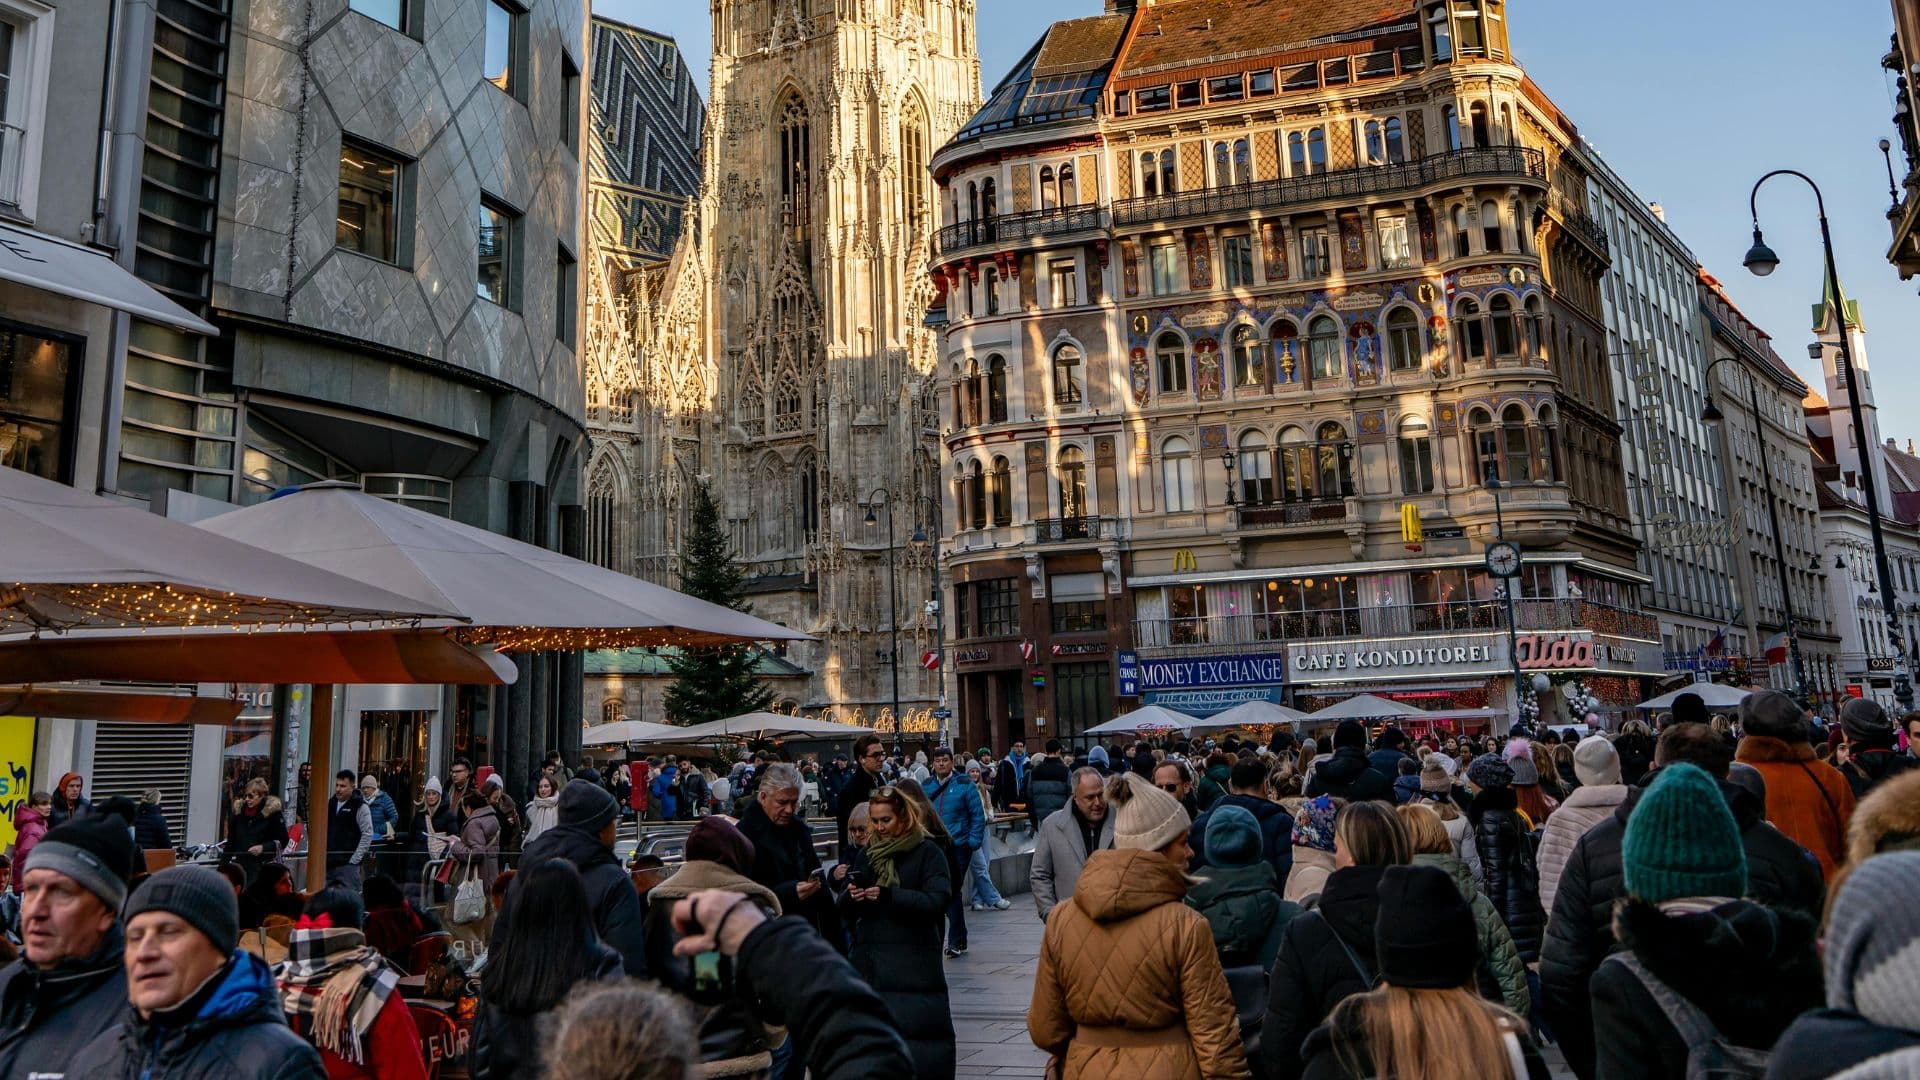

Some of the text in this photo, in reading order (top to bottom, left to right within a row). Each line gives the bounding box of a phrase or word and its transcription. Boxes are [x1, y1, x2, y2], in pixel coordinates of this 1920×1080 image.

[1632, 338, 1674, 500] HOTEL
[1651, 506, 1742, 561] Royal
[1354, 645, 1491, 668] KONDITOREI
[1119, 667, 1138, 679] CHANGE
[1140, 658, 1282, 686] MONEY EXCHANGE
[1155, 688, 1271, 705] THE CHANGE GROUP
